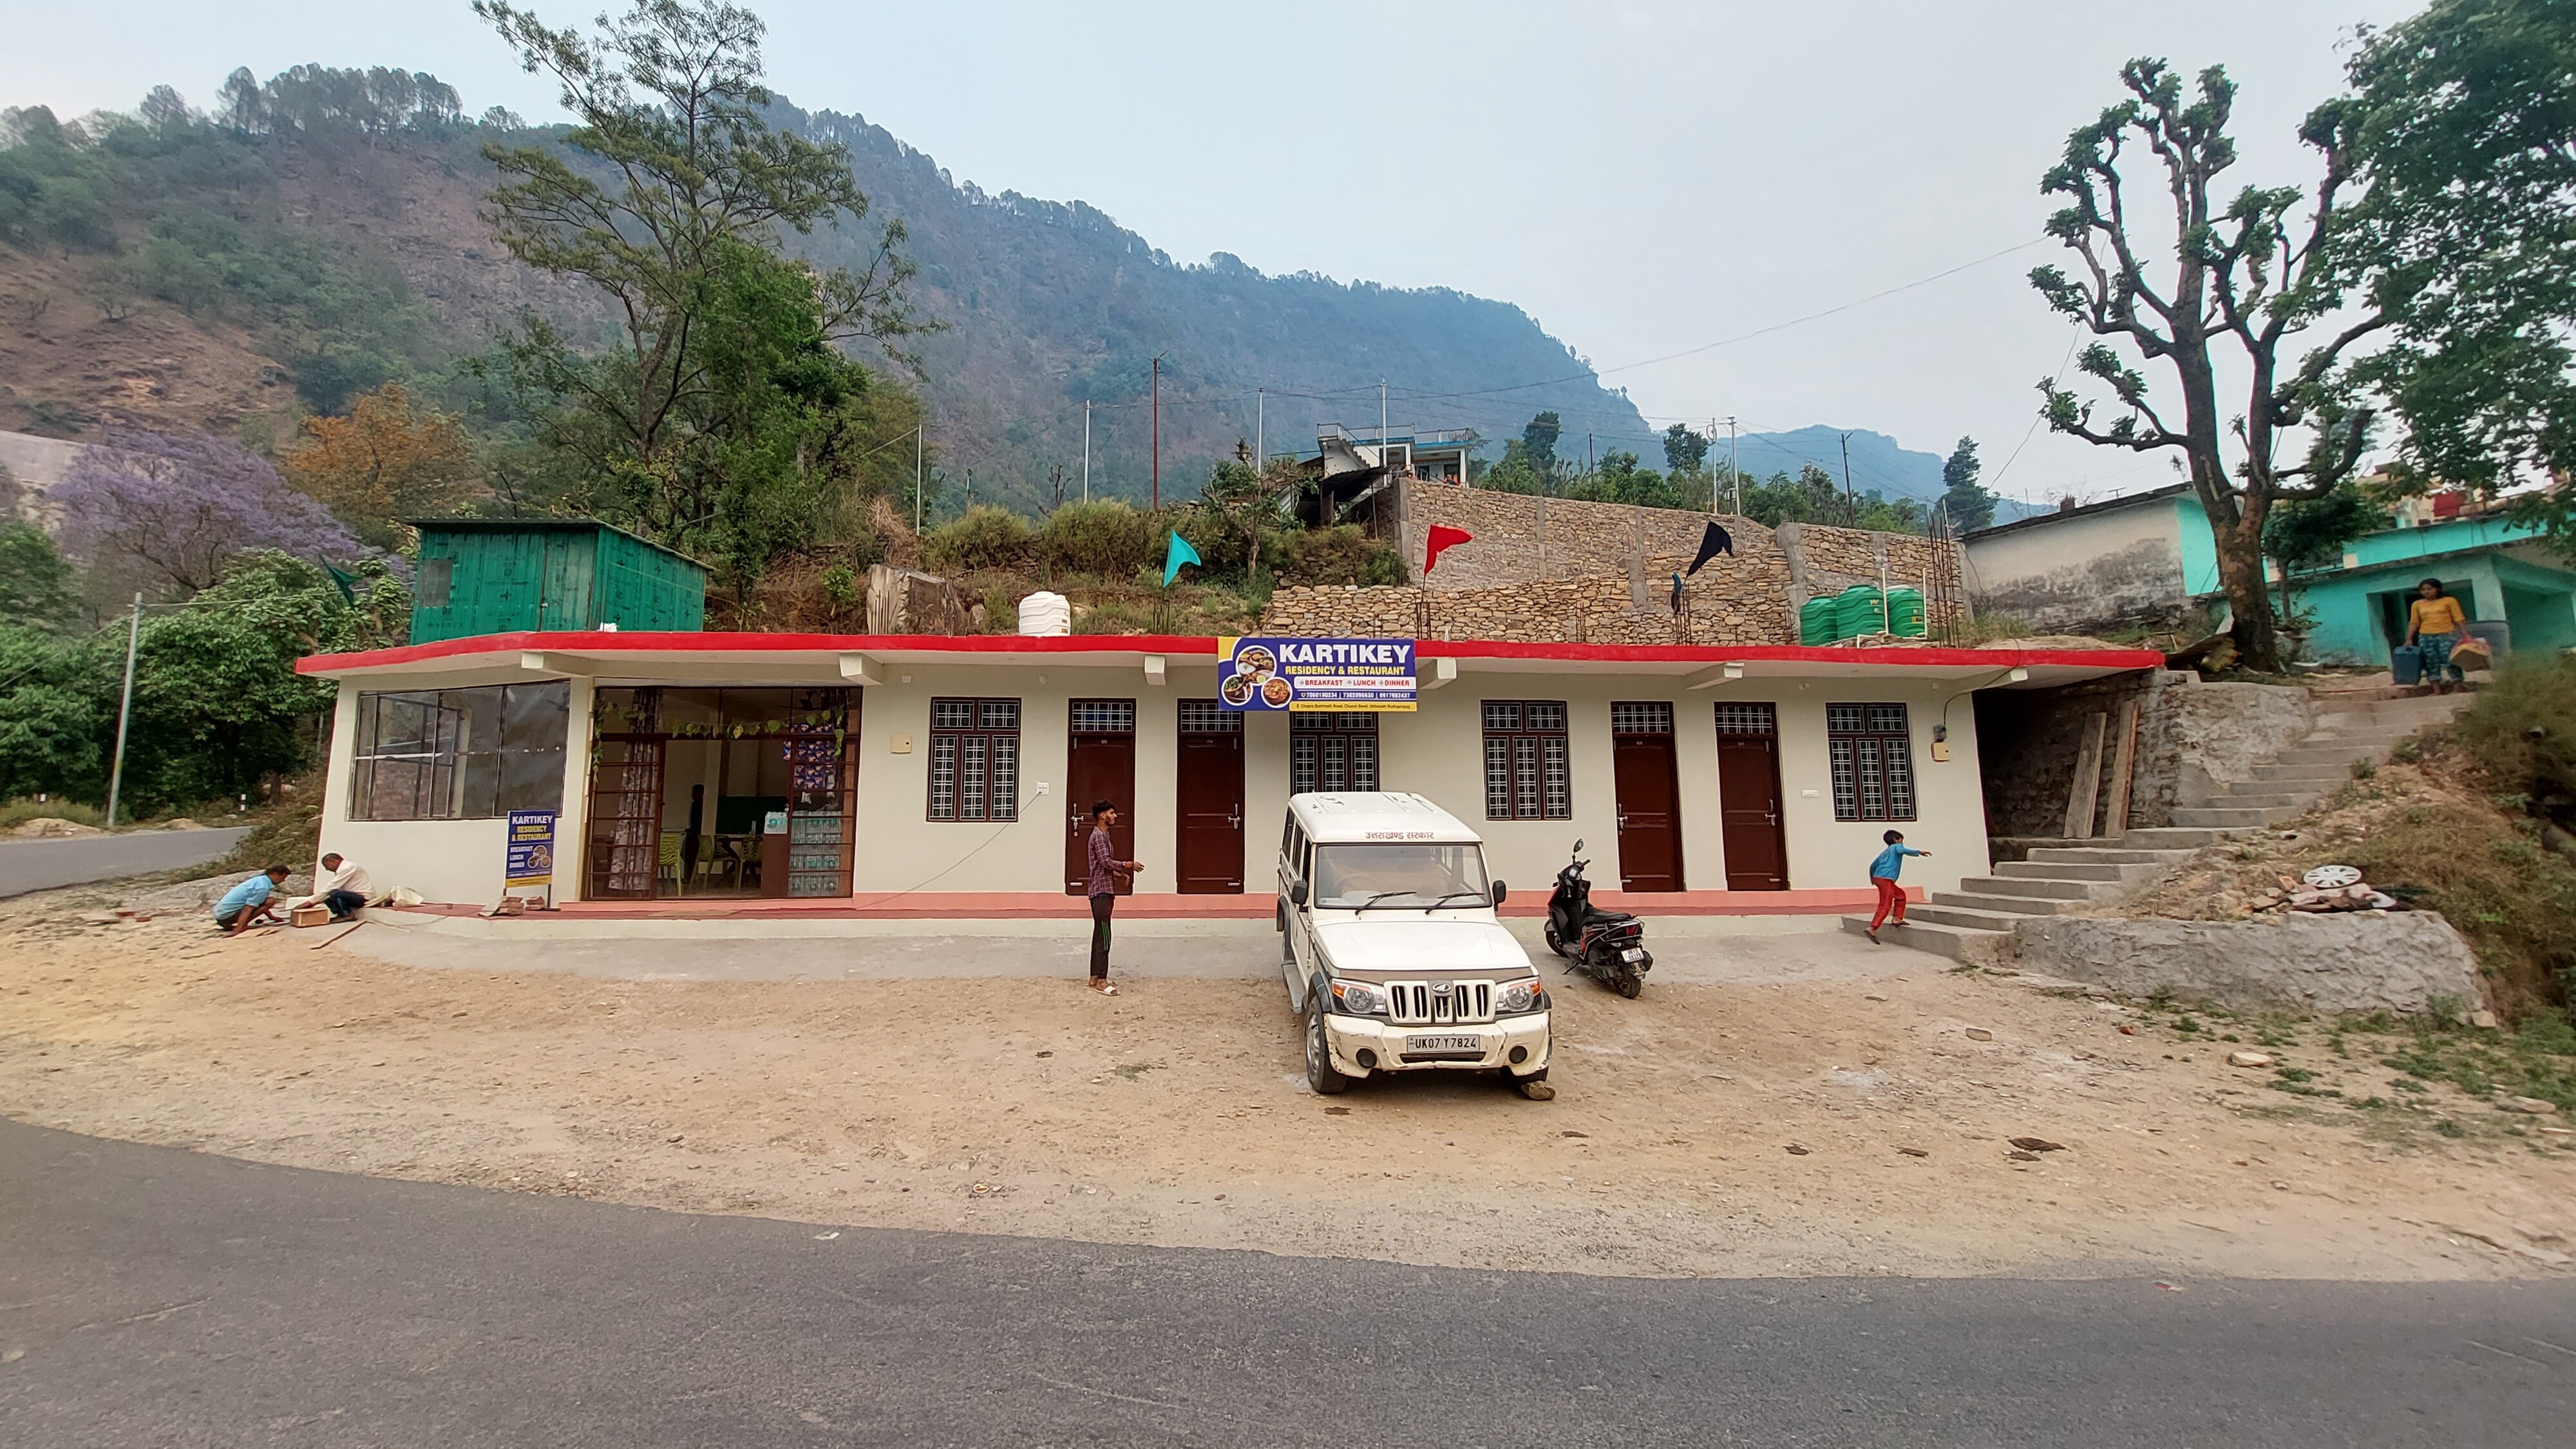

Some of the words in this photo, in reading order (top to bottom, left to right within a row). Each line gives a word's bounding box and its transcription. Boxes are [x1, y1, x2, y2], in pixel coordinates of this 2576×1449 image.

[1280, 644, 1410, 663] KARTIKEY
[1285, 666, 1336, 674] RESIDENCY
[1347, 666, 1405, 675] RESTAURANT
[512, 815, 553, 824] KARTIKEY
[1416, 1038, 1441, 1048] UK07
